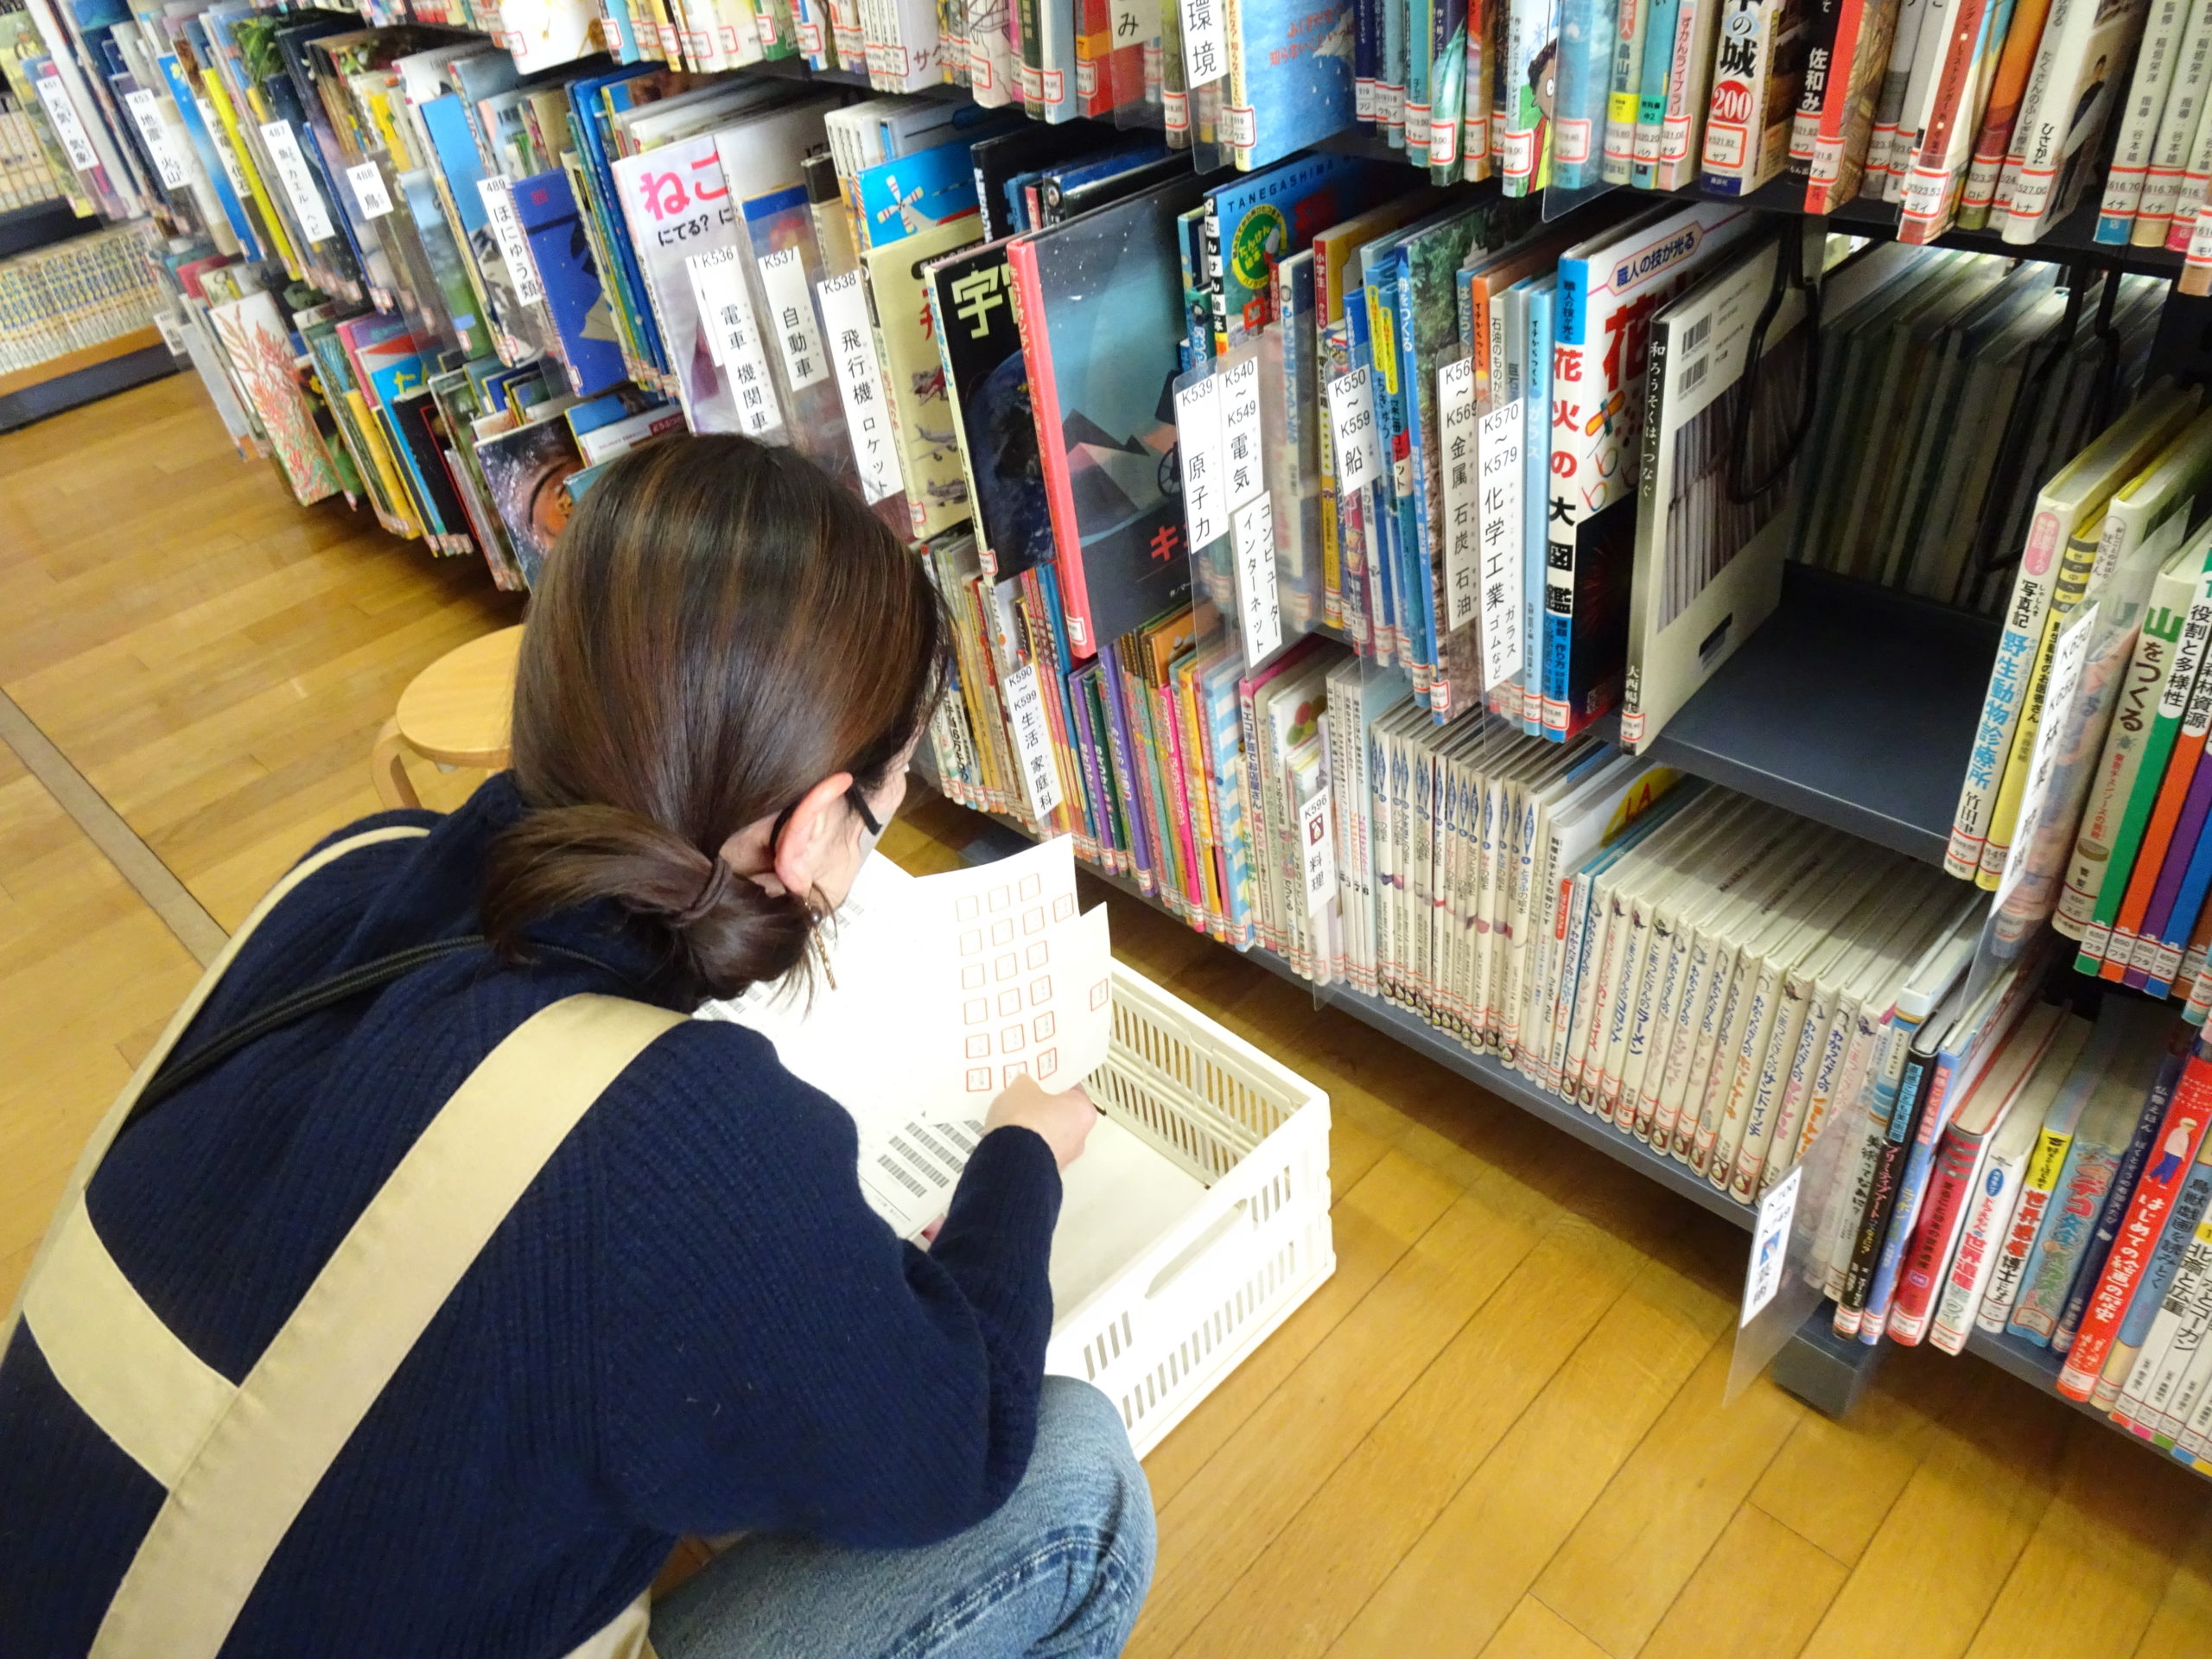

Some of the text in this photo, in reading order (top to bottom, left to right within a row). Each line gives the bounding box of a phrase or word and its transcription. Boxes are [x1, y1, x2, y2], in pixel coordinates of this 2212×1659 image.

[1118, 12, 1139, 36] み
[1187, 0, 1217, 76] 環境
[1712, 88, 1753, 121] 200
[486, 178, 506, 193] 489
[638, 150, 729, 222] ねこ
[1227, 159, 1335, 212] TANEGASHIMA
[493, 205, 539, 300] ほにゅう類
[702, 250, 735, 269] K536
[764, 250, 795, 270] K537
[1616, 232, 1695, 289] 職人の技が光る
[823, 274, 857, 295] K538
[719, 302, 769, 433] 電車 機関車
[781, 306, 814, 378] 自動車
[1181, 378, 1214, 407] K539
[1224, 359, 1255, 388] K540
[1334, 368, 1366, 398] K550
[1445, 357, 1477, 386] K560
[840, 328, 889, 494] 飛行機 ロケット
[1228, 399, 1257, 429] K549
[1340, 410, 1370, 439] K559
[1446, 399, 1478, 429] K569
[1484, 403, 1519, 435] K570
[1641, 340, 1666, 499] 和ろうそくは、つなぐ
[1230, 432, 1250, 494] 電気
[1344, 446, 1363, 476] 船
[1484, 445, 1517, 477] K579
[1543, 346, 1586, 615] 花火の大図鑑
[1188, 450, 1211, 543] 原子力
[1149, 524, 1190, 562] キ
[1450, 435, 1472, 620] 金属・石炭・石油
[1484, 486, 1505, 613] 化学工業
[1243, 512, 1265, 655] インターネット
[1260, 505, 1280, 638] コンピューター
[2012, 578, 2039, 629] 写真記
[1488, 615, 1501, 681] ゴムなど
[1503, 605, 1517, 660] ガラス
[2162, 604, 2212, 709] 役割と多様性
[1008, 664, 1033, 688] K590
[2120, 606, 2186, 734] 山をつくる
[1013, 690, 1038, 712] K599
[1967, 631, 2031, 791] 野生動物診療所
[1020, 711, 1053, 811] 生活 家庭科
[1303, 794, 1329, 821] K596
[1308, 850, 1325, 893] 料理
[2093, 1194, 2165, 1323] はじめての絵画の歴史
